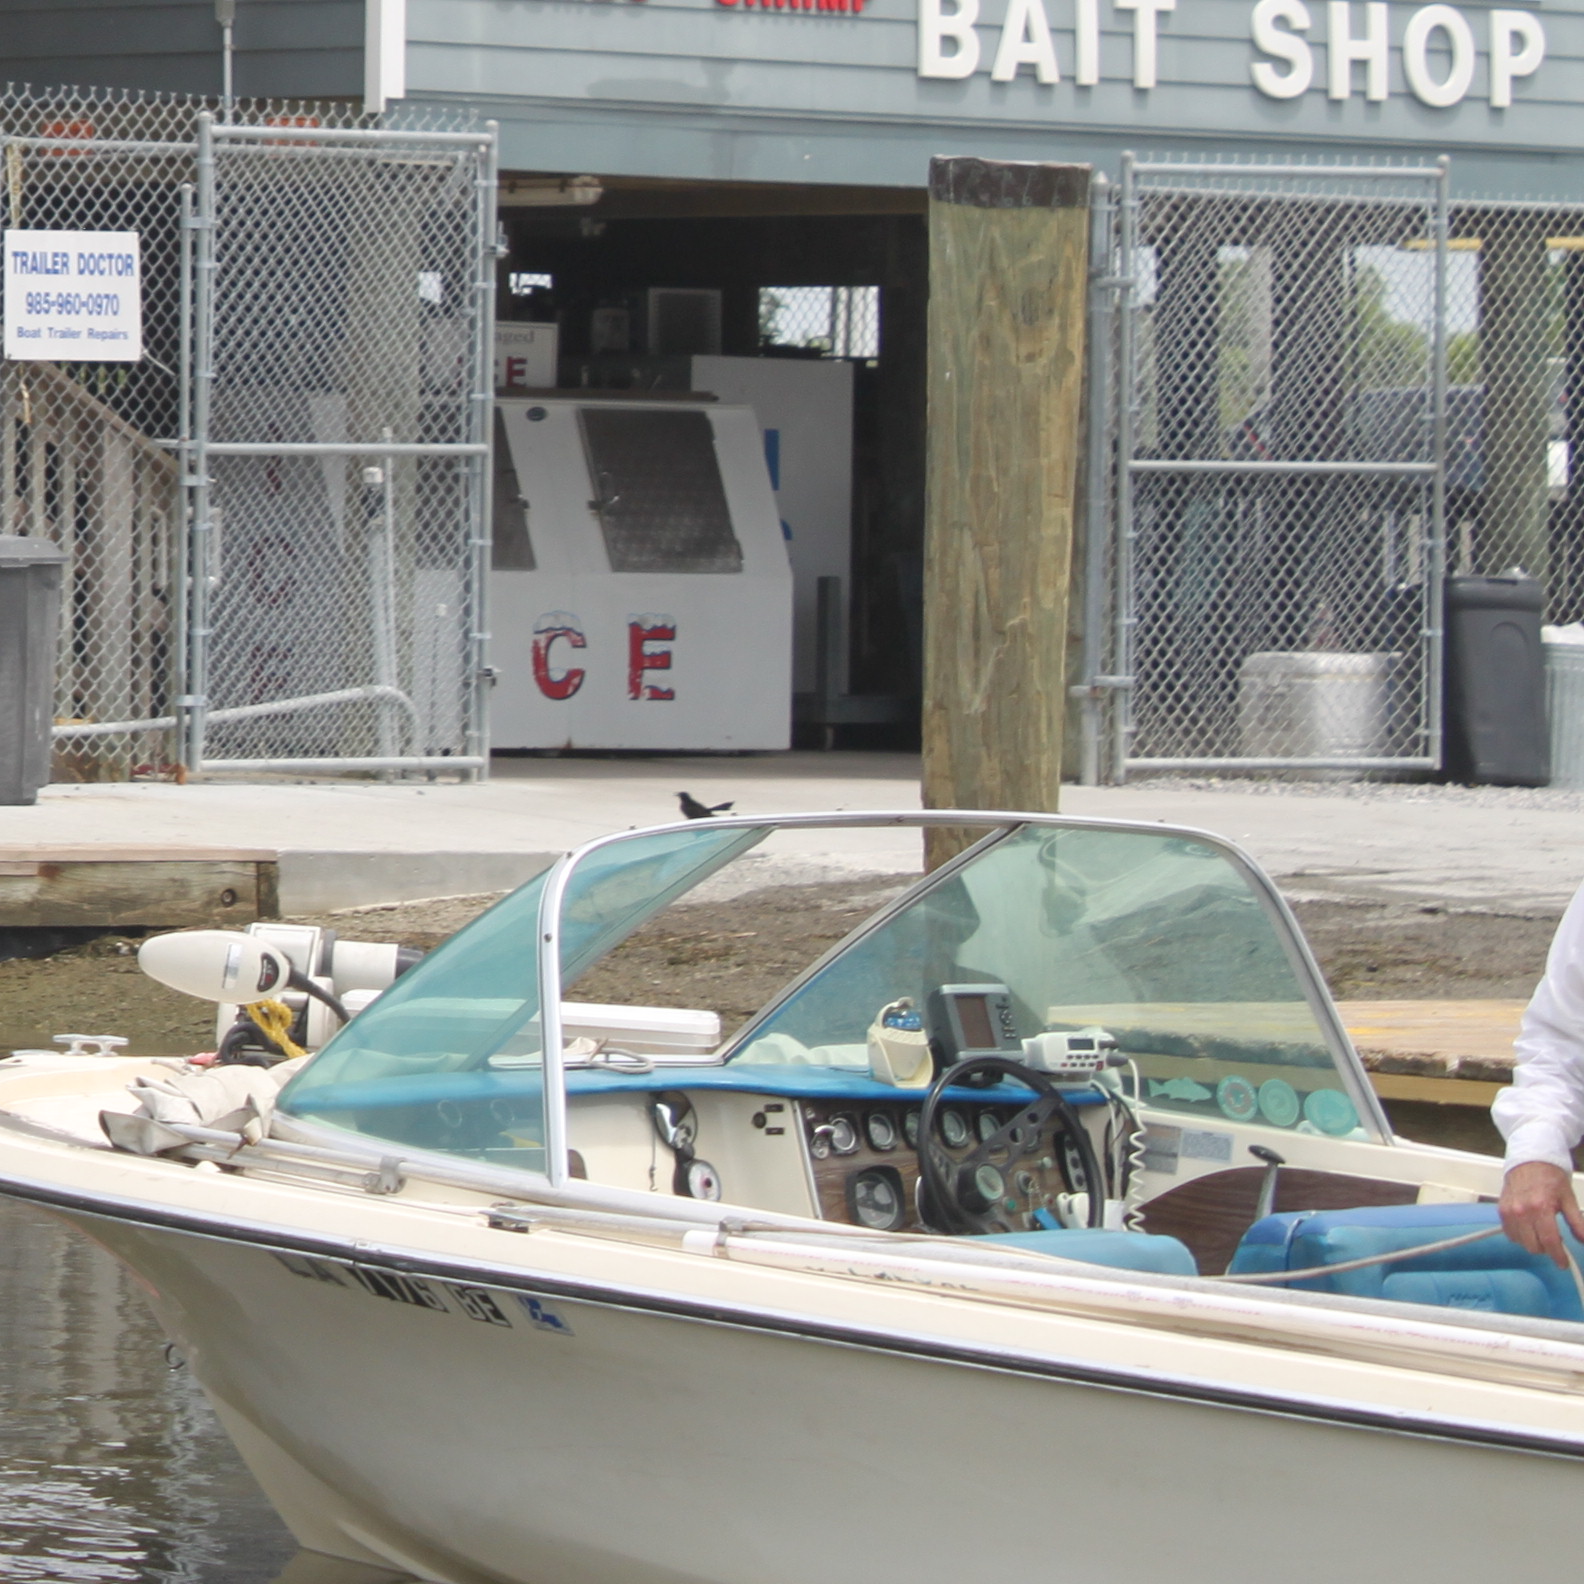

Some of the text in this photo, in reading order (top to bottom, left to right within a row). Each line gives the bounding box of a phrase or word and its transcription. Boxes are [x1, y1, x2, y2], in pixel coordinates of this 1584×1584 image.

[12, 251, 134, 276] TRAILER DOCTOR
[26, 291, 120, 316] 985-960-0970
[17, 326, 129, 341] Boat Trailer Repairs
[530, 610, 677, 702] CE
